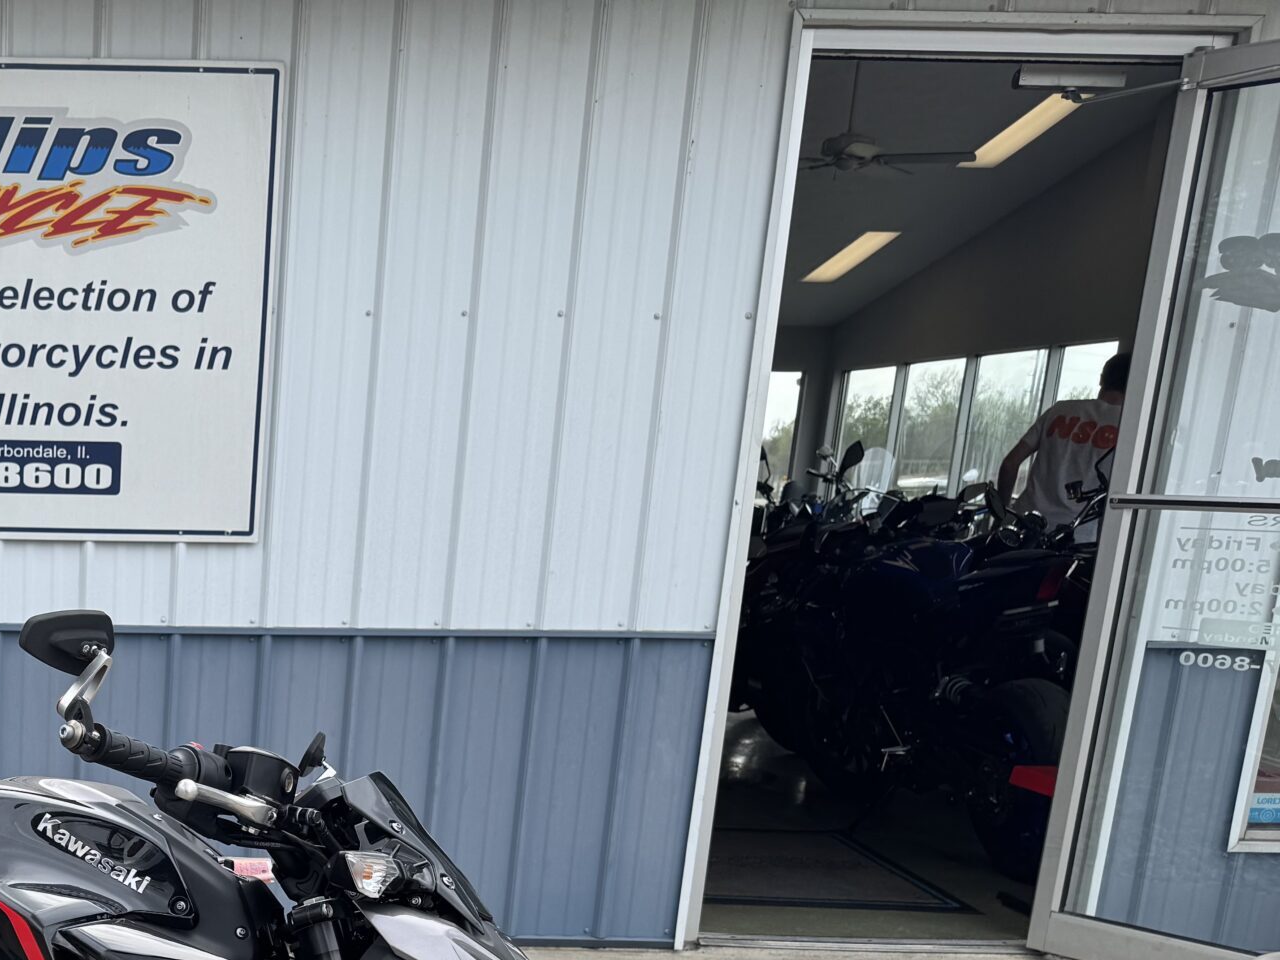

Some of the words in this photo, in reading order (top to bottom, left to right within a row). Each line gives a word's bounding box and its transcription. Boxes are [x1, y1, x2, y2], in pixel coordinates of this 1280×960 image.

[171, 281, 217, 313] of
[194, 337, 233, 370] in
[37, 813, 151, 894] Kawasaki
